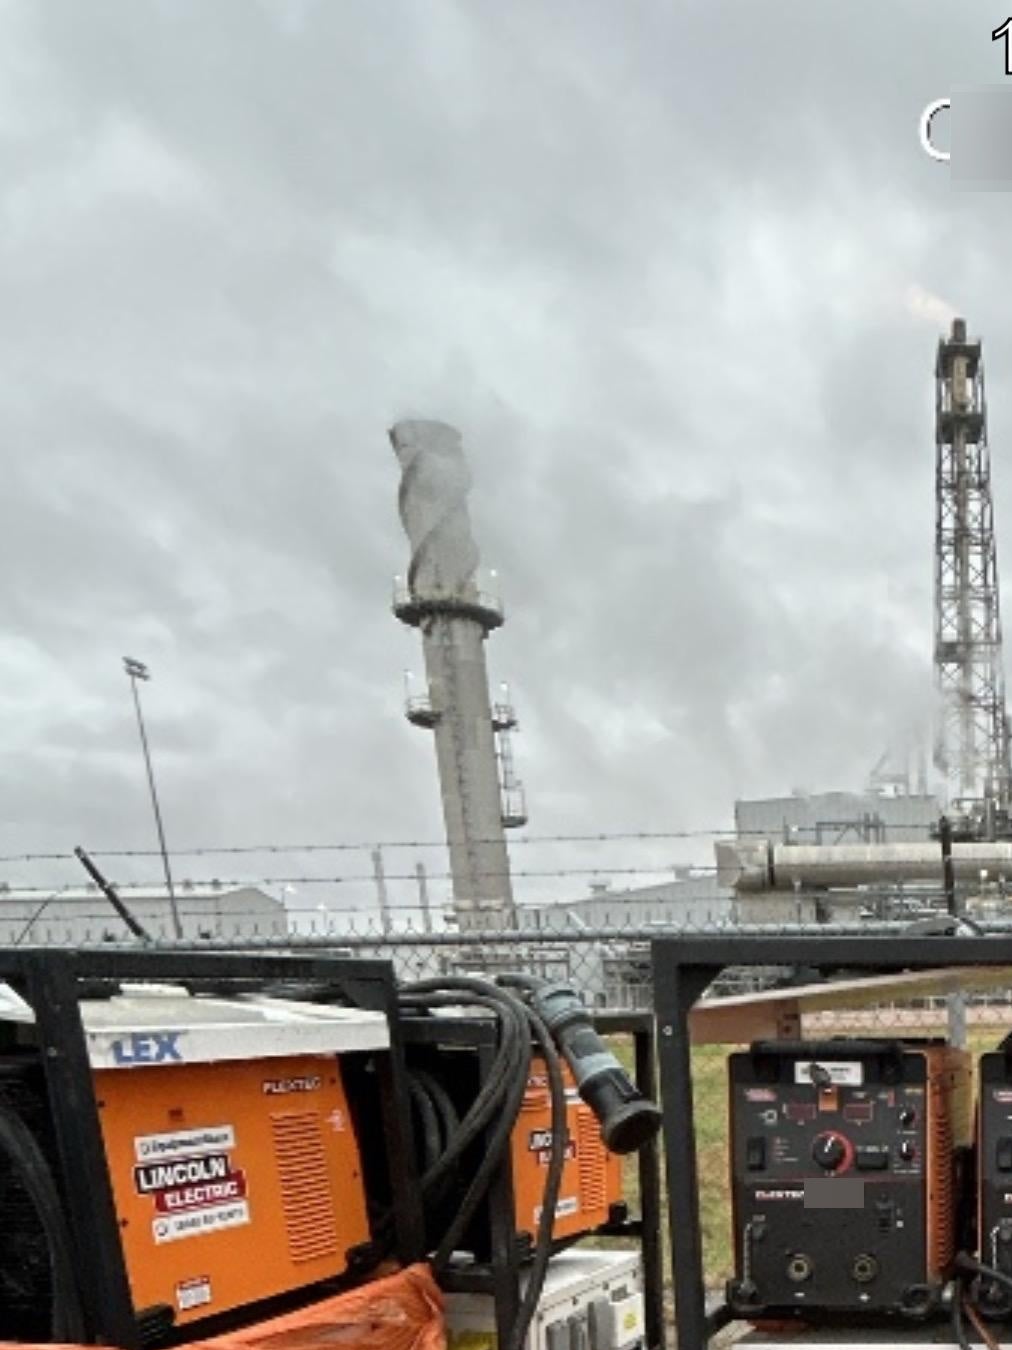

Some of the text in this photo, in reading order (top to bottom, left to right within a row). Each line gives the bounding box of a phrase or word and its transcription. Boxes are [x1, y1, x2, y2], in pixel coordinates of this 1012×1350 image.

[112, 1030, 184, 1065] LEX
[138, 1156, 226, 1191] LINCOLN
[164, 1181, 238, 1207] ELECTRIC
